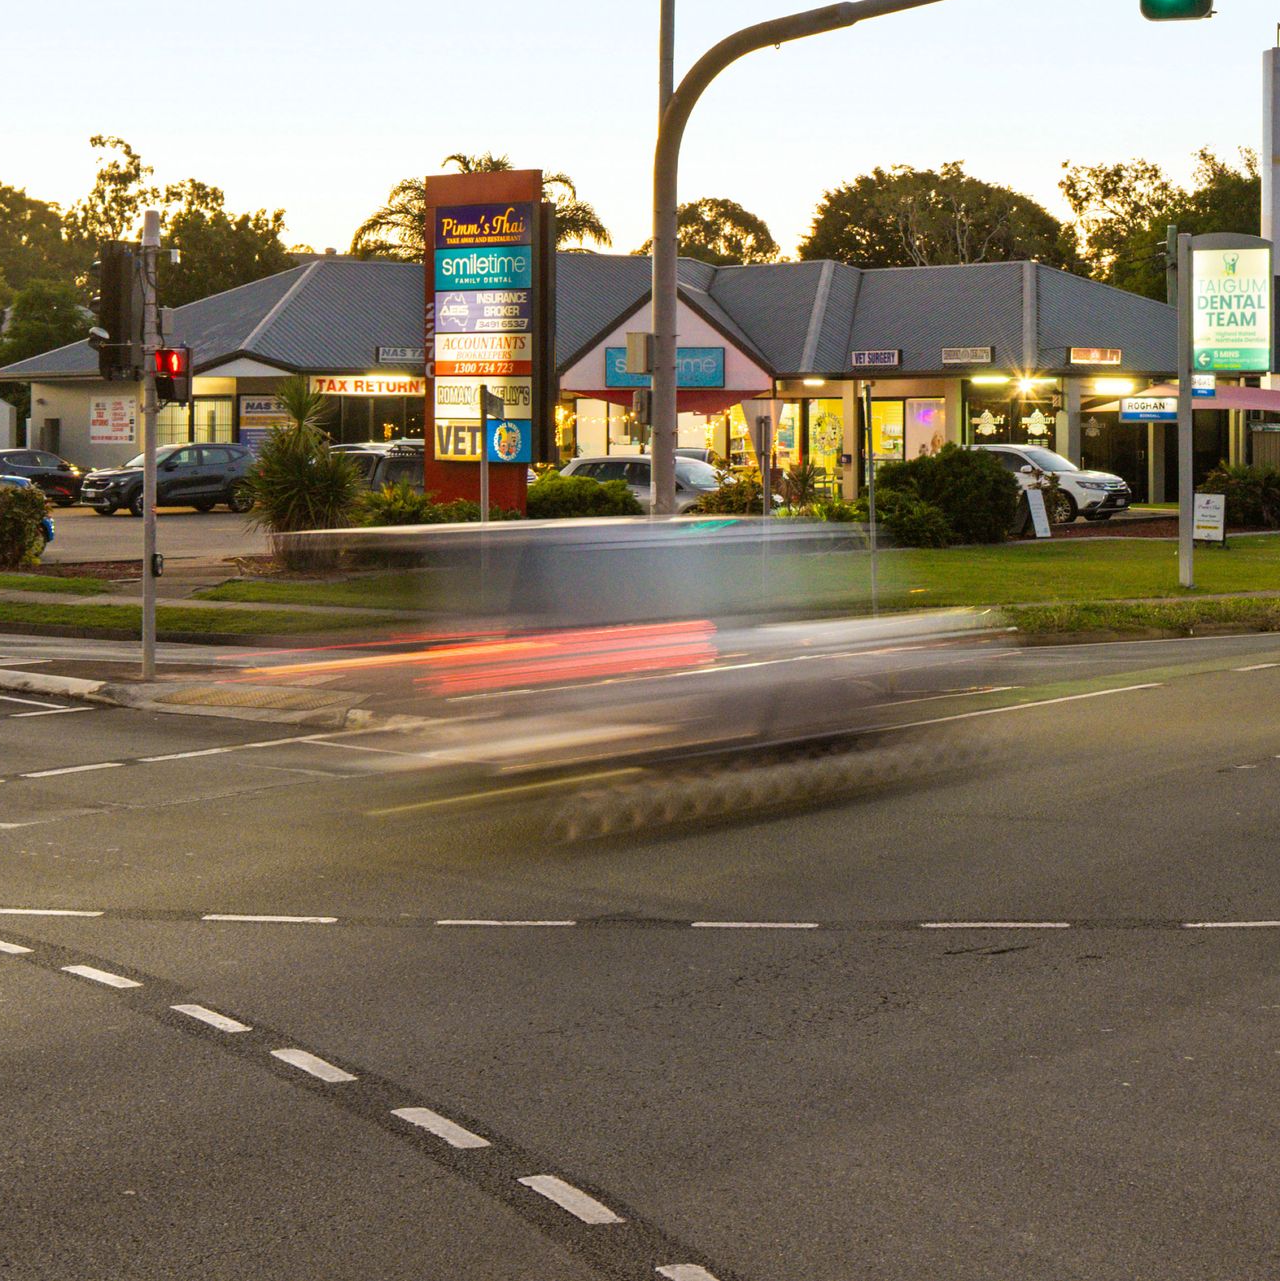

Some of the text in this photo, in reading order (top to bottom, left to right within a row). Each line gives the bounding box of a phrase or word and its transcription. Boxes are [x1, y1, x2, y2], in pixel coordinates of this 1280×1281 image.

[441, 207, 526, 236] Pimm's Thai
[442, 253, 526, 276] smiletime
[1197, 278, 1266, 294] TAIGUM
[476, 292, 527, 304] INSURANCE
[1197, 294, 1266, 310] DENTAL
[483, 305, 520, 317] BROKER
[478, 320, 525, 328] 3491 6532
[1206, 311, 1257, 327] TEAM
[443, 336, 526, 350] ACCOUNTANTS
[381, 349, 407, 357] NAS
[455, 351, 512, 360] BOOKKEEPERS
[854, 351, 896, 364] VET SURGERY
[454, 363, 514, 374] 1300 734 723
[316, 379, 348, 393] TAX
[437, 385, 473, 405] ROMAN
[1127, 402, 1165, 410] ROGHAN
[437, 425, 481, 456] VET
